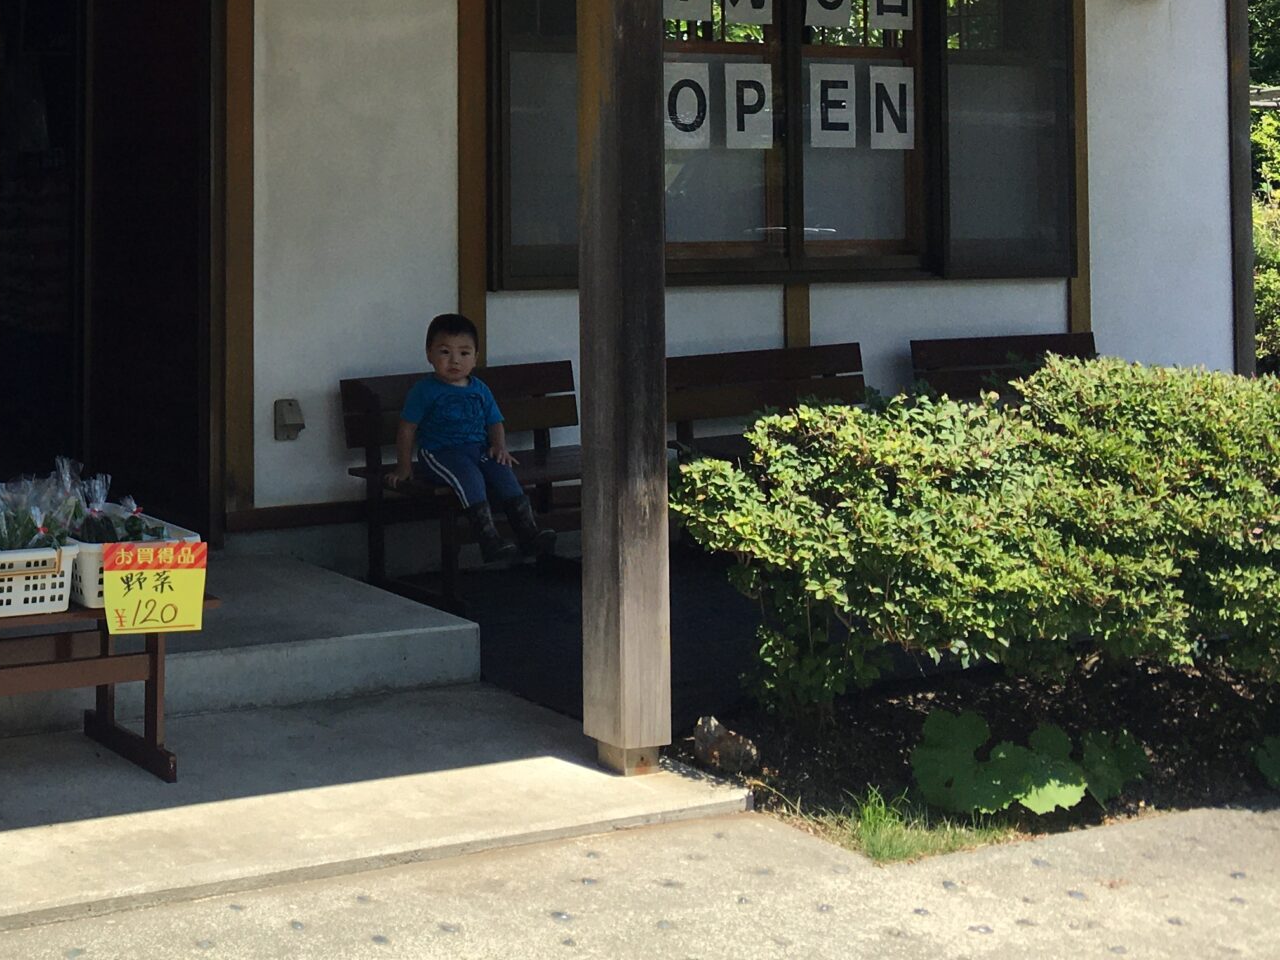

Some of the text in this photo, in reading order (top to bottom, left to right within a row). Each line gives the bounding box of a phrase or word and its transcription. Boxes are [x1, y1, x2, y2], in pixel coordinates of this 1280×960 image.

[667, 78, 908, 133] OPEN
[114, 547, 195, 565] お買得品
[120, 570, 174, 598] 野菜
[114, 598, 178, 628] ¥120
